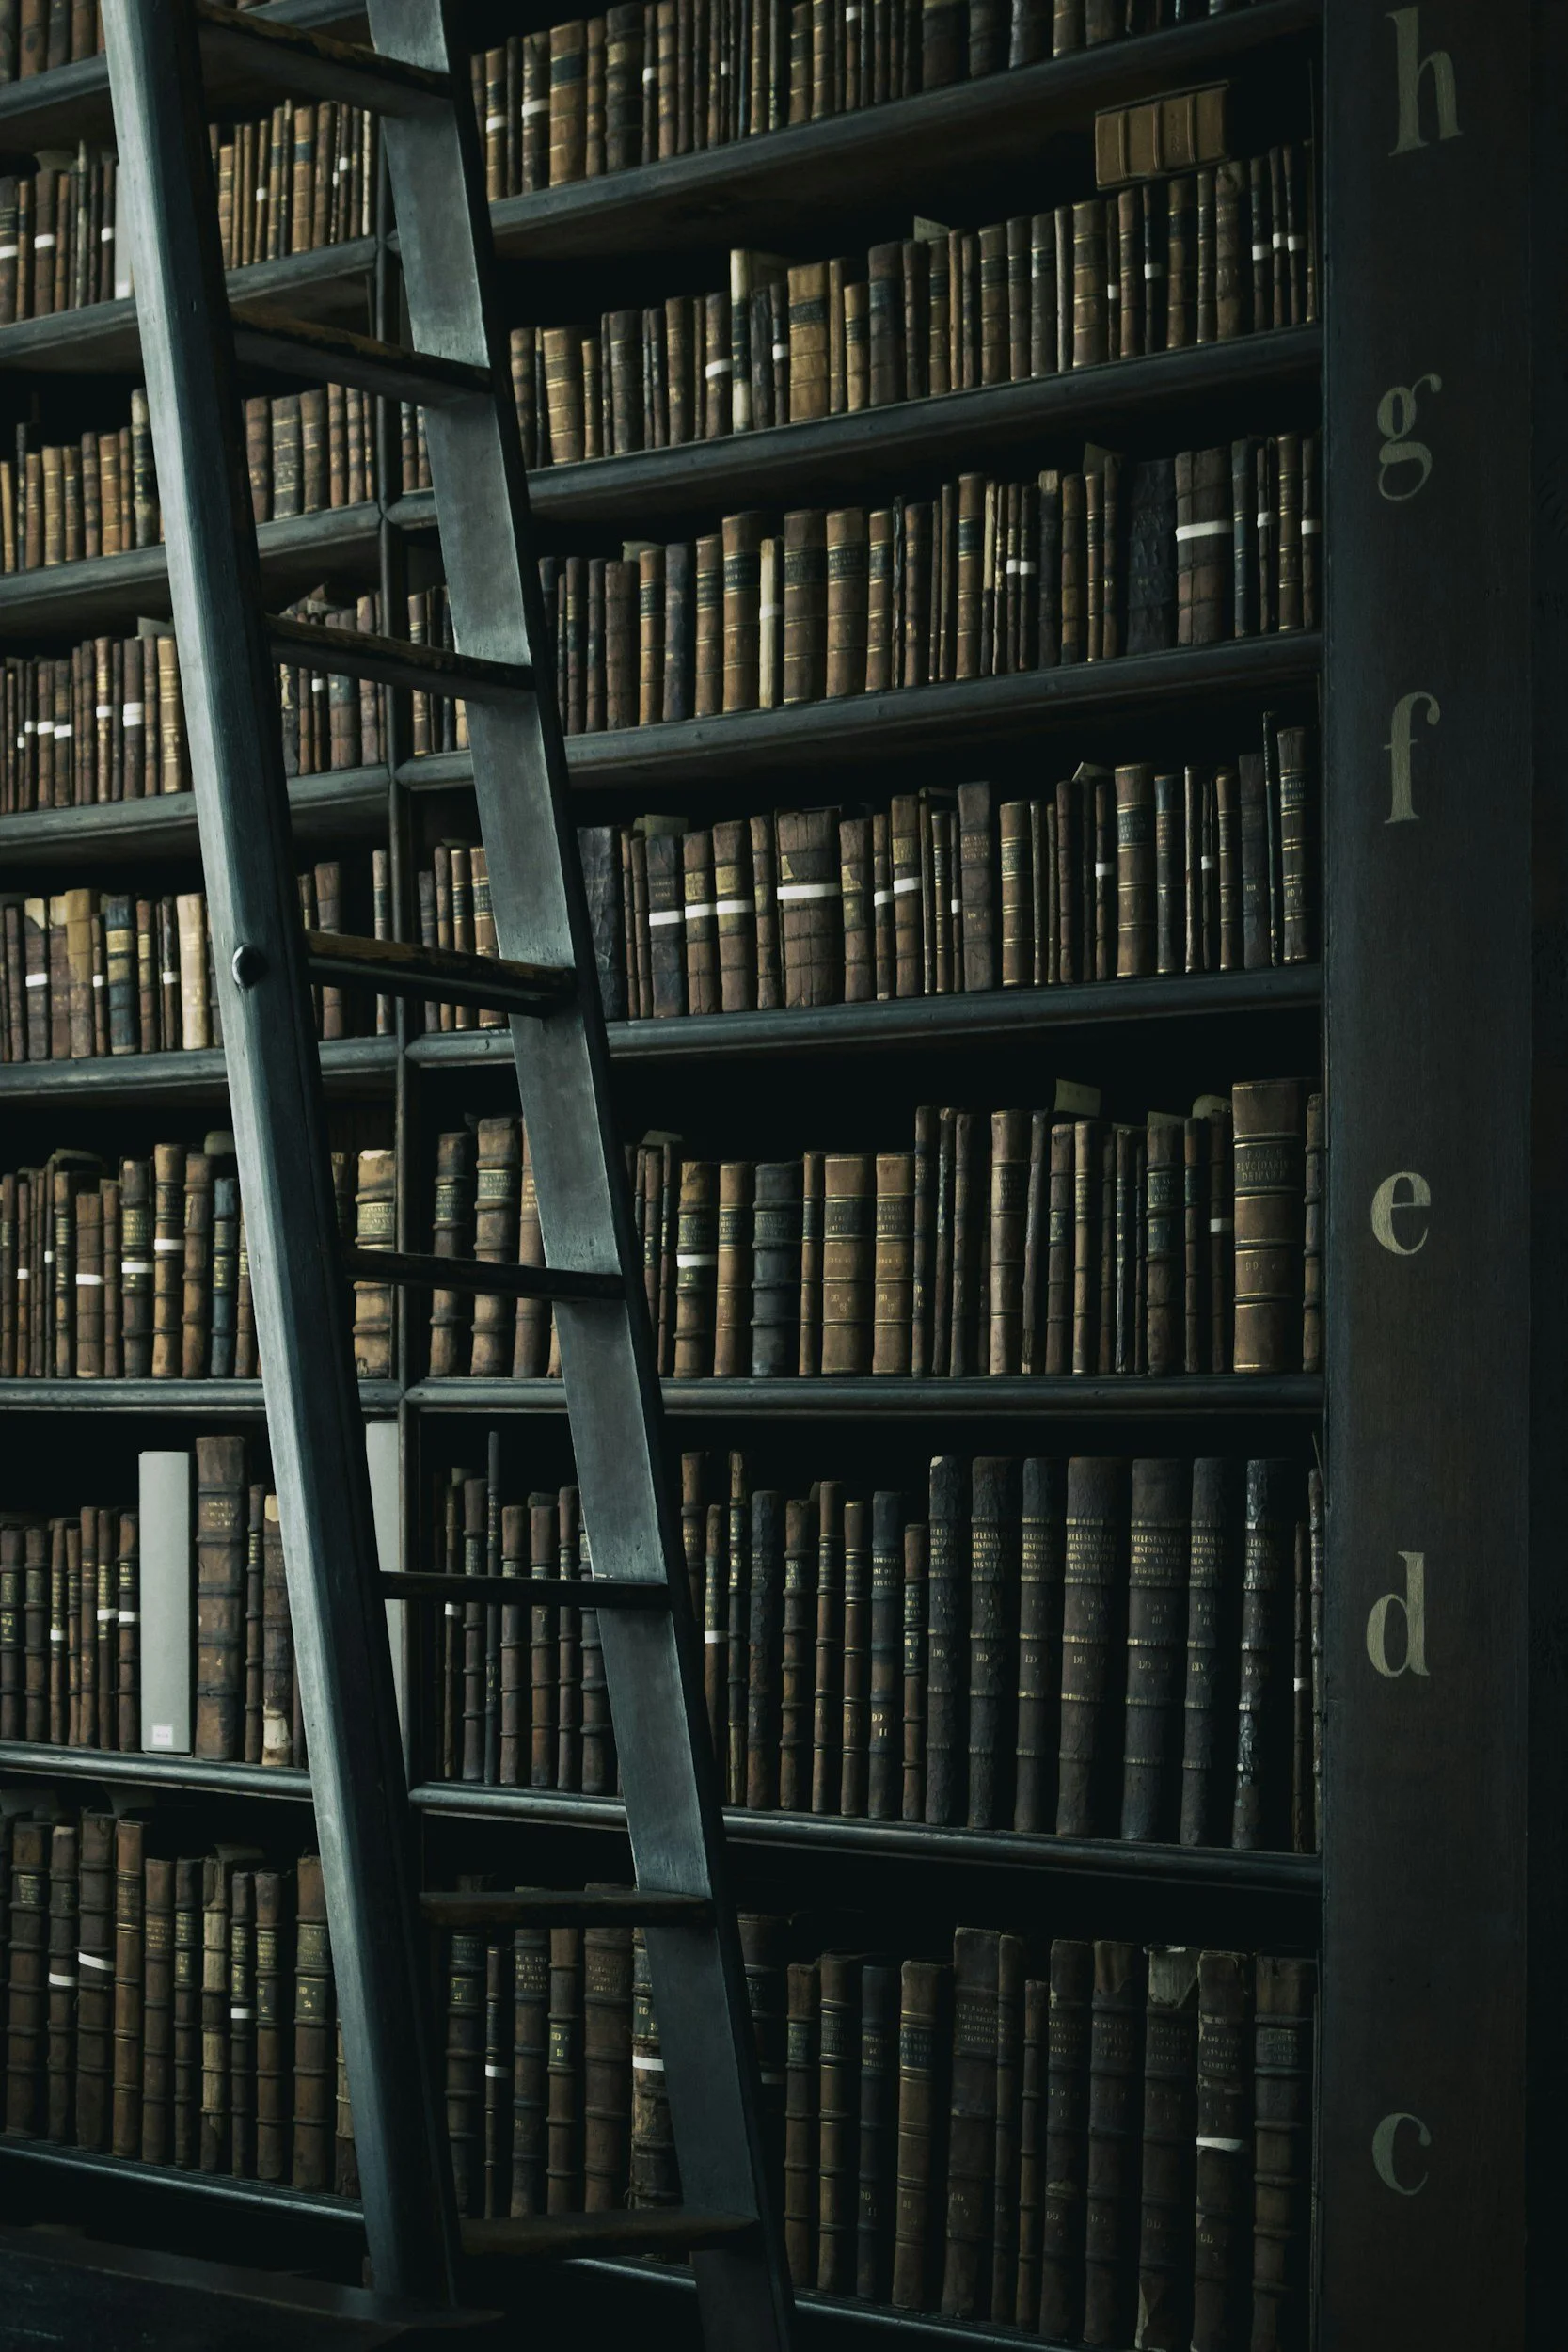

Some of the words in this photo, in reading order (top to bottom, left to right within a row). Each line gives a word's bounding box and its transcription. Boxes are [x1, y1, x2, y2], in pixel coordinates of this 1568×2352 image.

[1385, 6, 1464, 156] h
[1376, 373, 1442, 501] g
[1384, 691, 1440, 825] f
[1370, 1170, 1435, 1257] e
[1365, 1549, 1432, 1679] d
[1372, 2112, 1432, 2196] c
